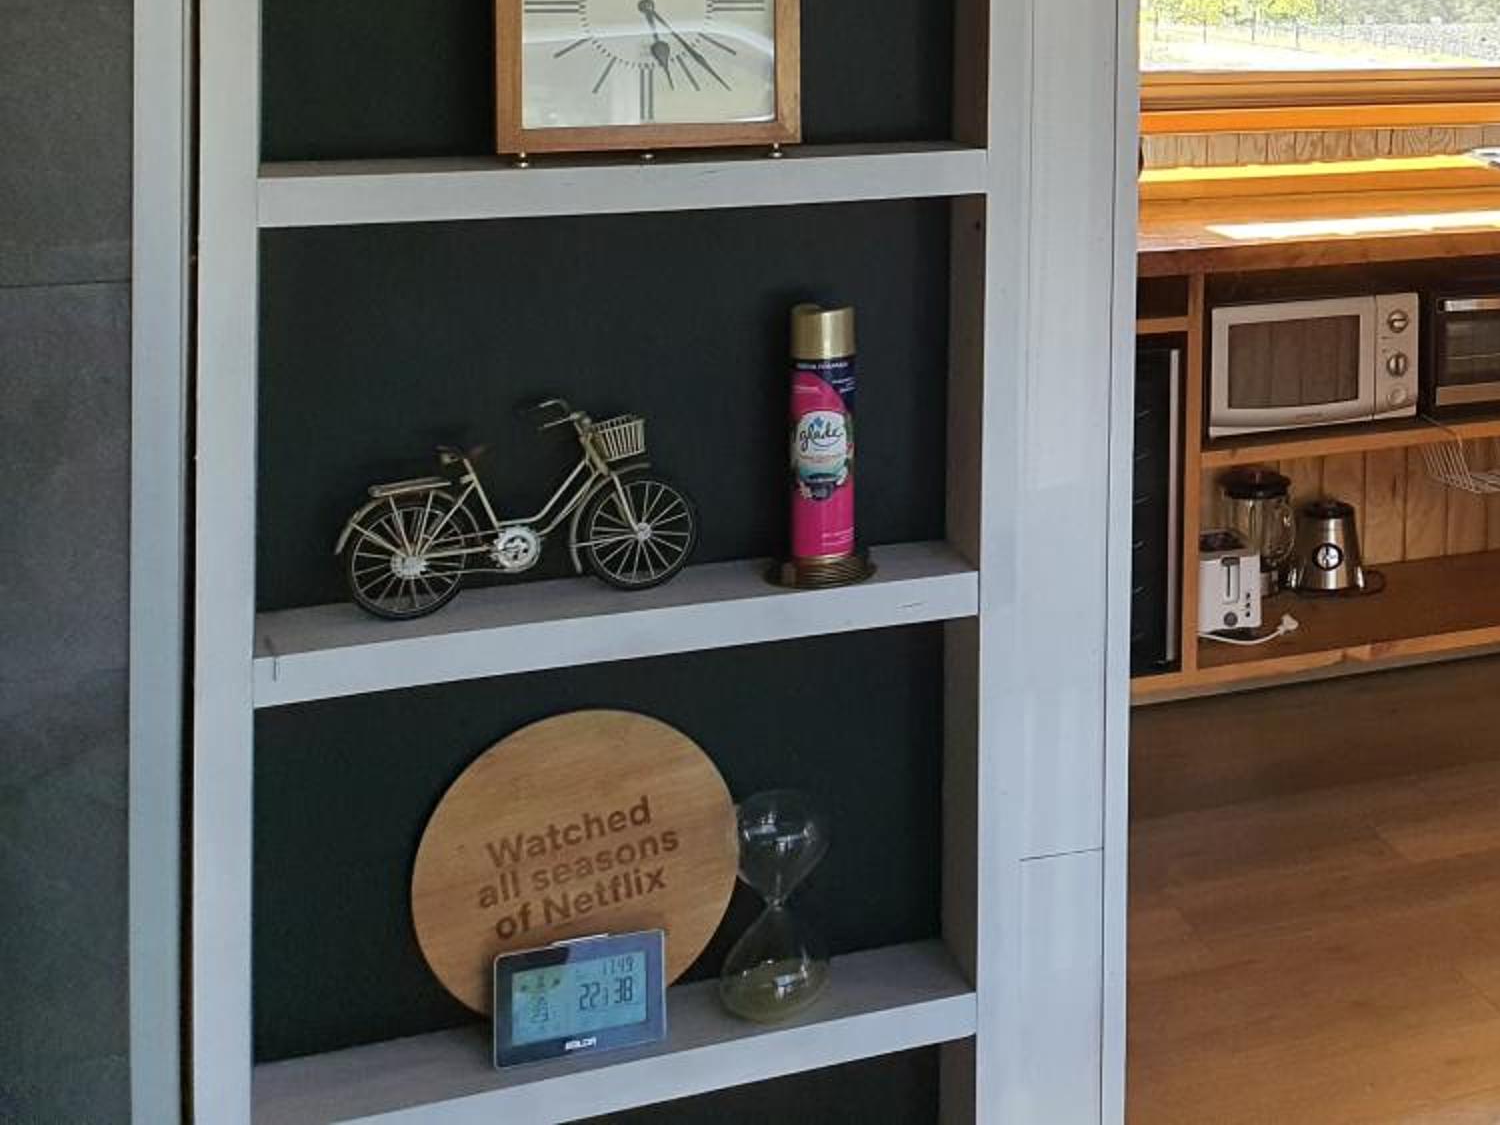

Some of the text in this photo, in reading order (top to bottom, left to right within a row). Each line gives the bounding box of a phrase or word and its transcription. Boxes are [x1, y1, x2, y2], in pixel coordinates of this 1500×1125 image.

[799, 422, 843, 451] glade
[486, 795, 651, 868] Watched
[479, 830, 680, 908] all seasons
[496, 866, 666, 939] of Netflix
